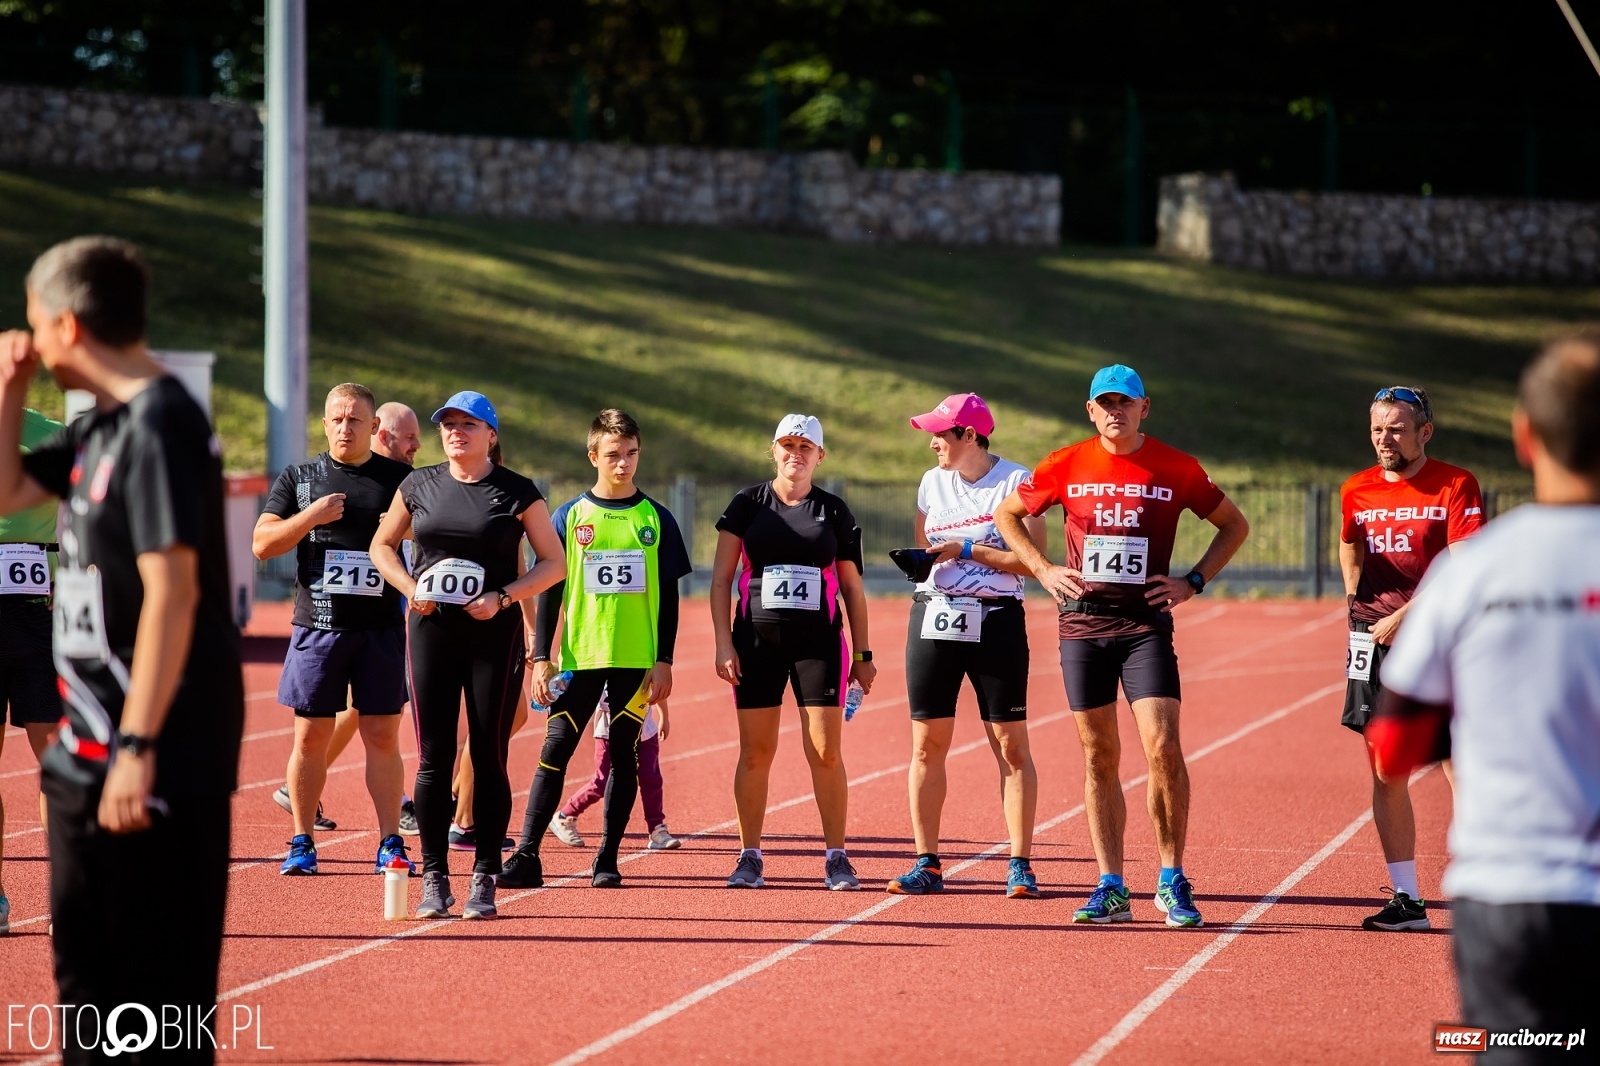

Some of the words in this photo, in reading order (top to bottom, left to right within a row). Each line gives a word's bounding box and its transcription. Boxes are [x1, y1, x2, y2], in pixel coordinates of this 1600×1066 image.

[1067, 483, 1173, 502] DAR-BUD
[1353, 506, 1447, 526] DAR-BUD
[0, 561, 47, 585] 66
[1087, 551, 1144, 576] 145
[326, 565, 382, 588] 215
[422, 573, 480, 597] 100
[597, 564, 633, 586] 65
[773, 580, 810, 602] 44
[312, 599, 333, 608] MADE
[934, 611, 969, 633] 64
